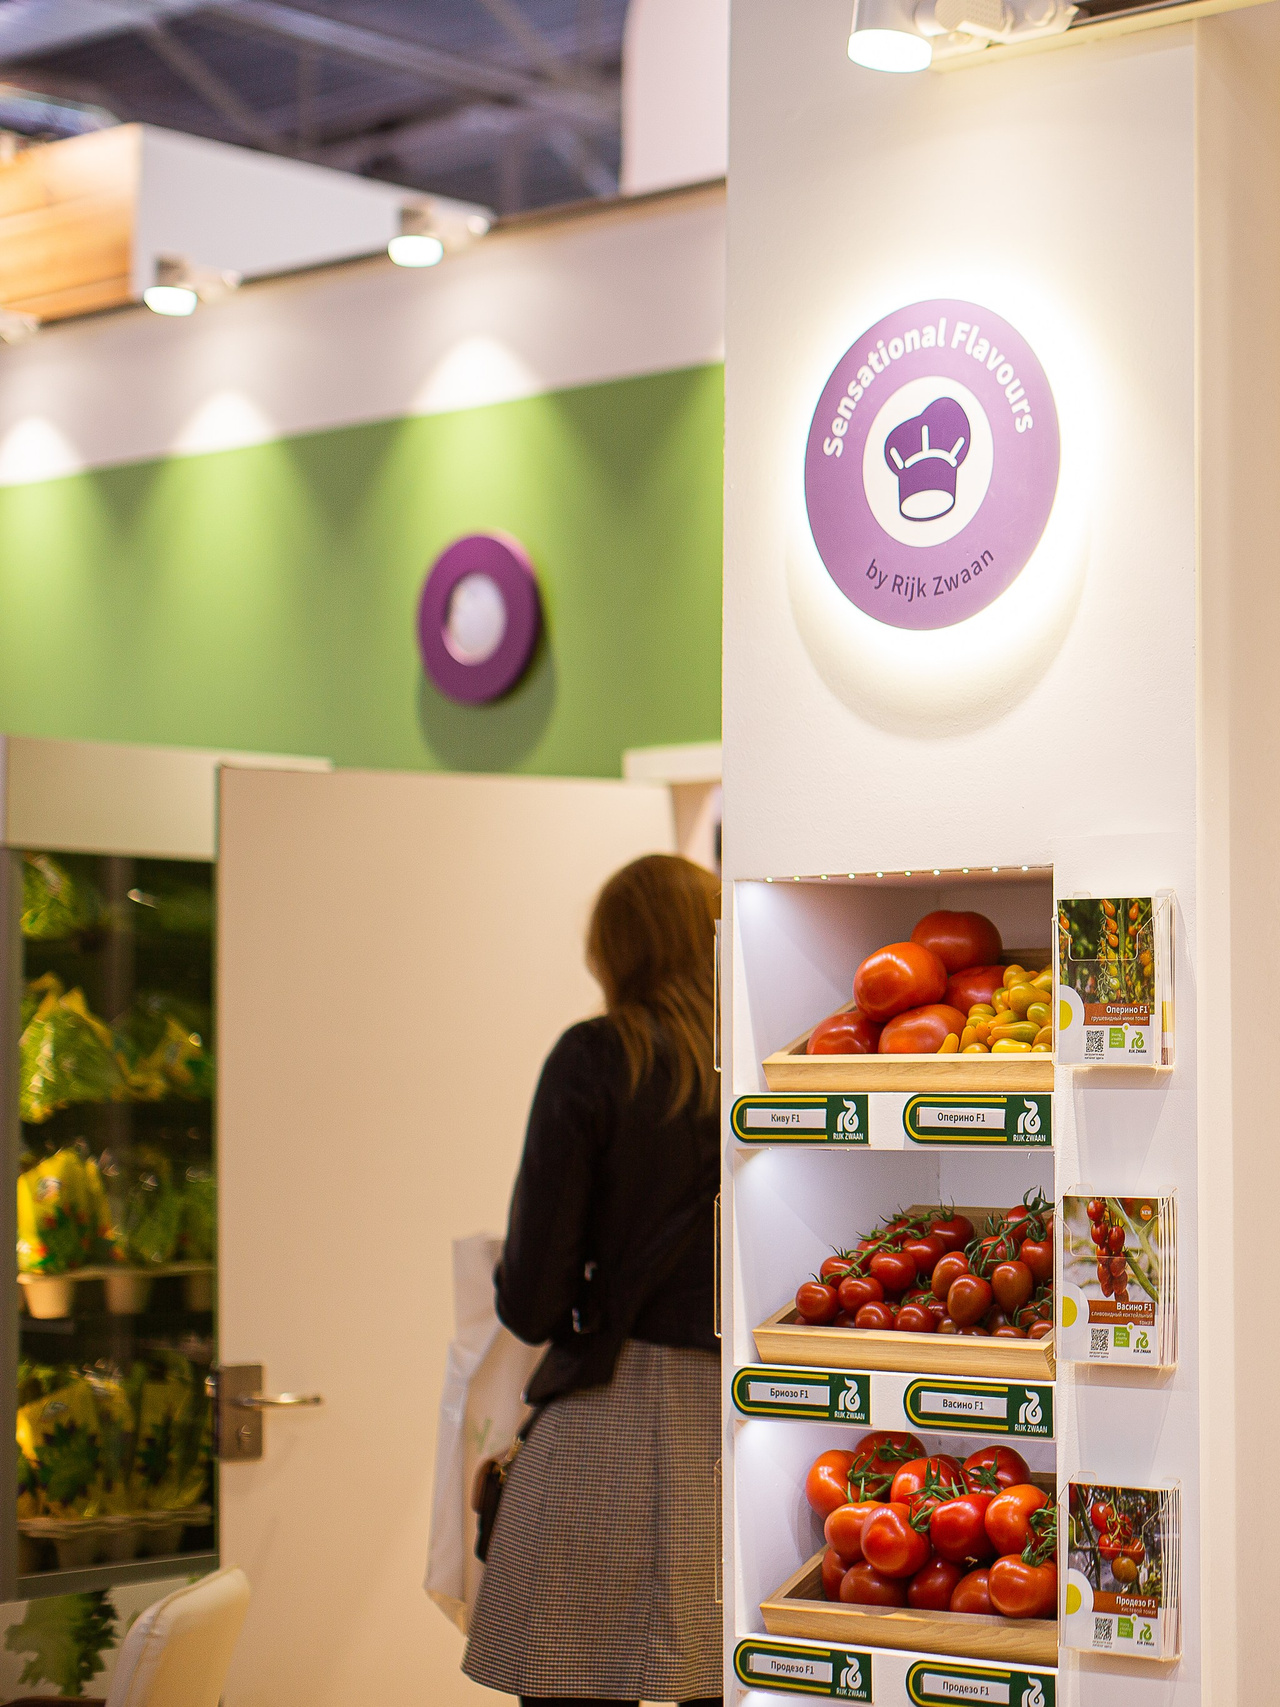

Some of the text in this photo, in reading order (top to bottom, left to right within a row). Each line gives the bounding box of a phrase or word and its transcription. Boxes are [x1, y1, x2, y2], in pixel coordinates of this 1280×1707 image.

[823, 317, 1033, 458] Sensational Flavours
[866, 549, 994, 602] by Rijk Zwaan
[1106, 1006, 1138, 1015] Оперино
[771, 1113, 800, 1125] Киву F1
[937, 1112, 985, 1123] Оперино F1
[833, 1132, 863, 1140] RIJK ZWAAN
[1013, 1134, 1046, 1142] RIJK ZWAAN
[1116, 1303, 1152, 1312] Васино F1
[770, 1387, 809, 1399] Бриозо F1
[942, 1398, 984, 1411] Васино F1
[834, 1410, 865, 1420] RIJK ZWAAN
[1014, 1424, 1047, 1433] RIJK ZWAAN
[1116, 1596, 1156, 1608] Продезо F1
[771, 1660, 814, 1675] Продезо F1
[836, 1688, 867, 1698] RIJK ZWAAN
[942, 1681, 989, 1696] Продезо F1
